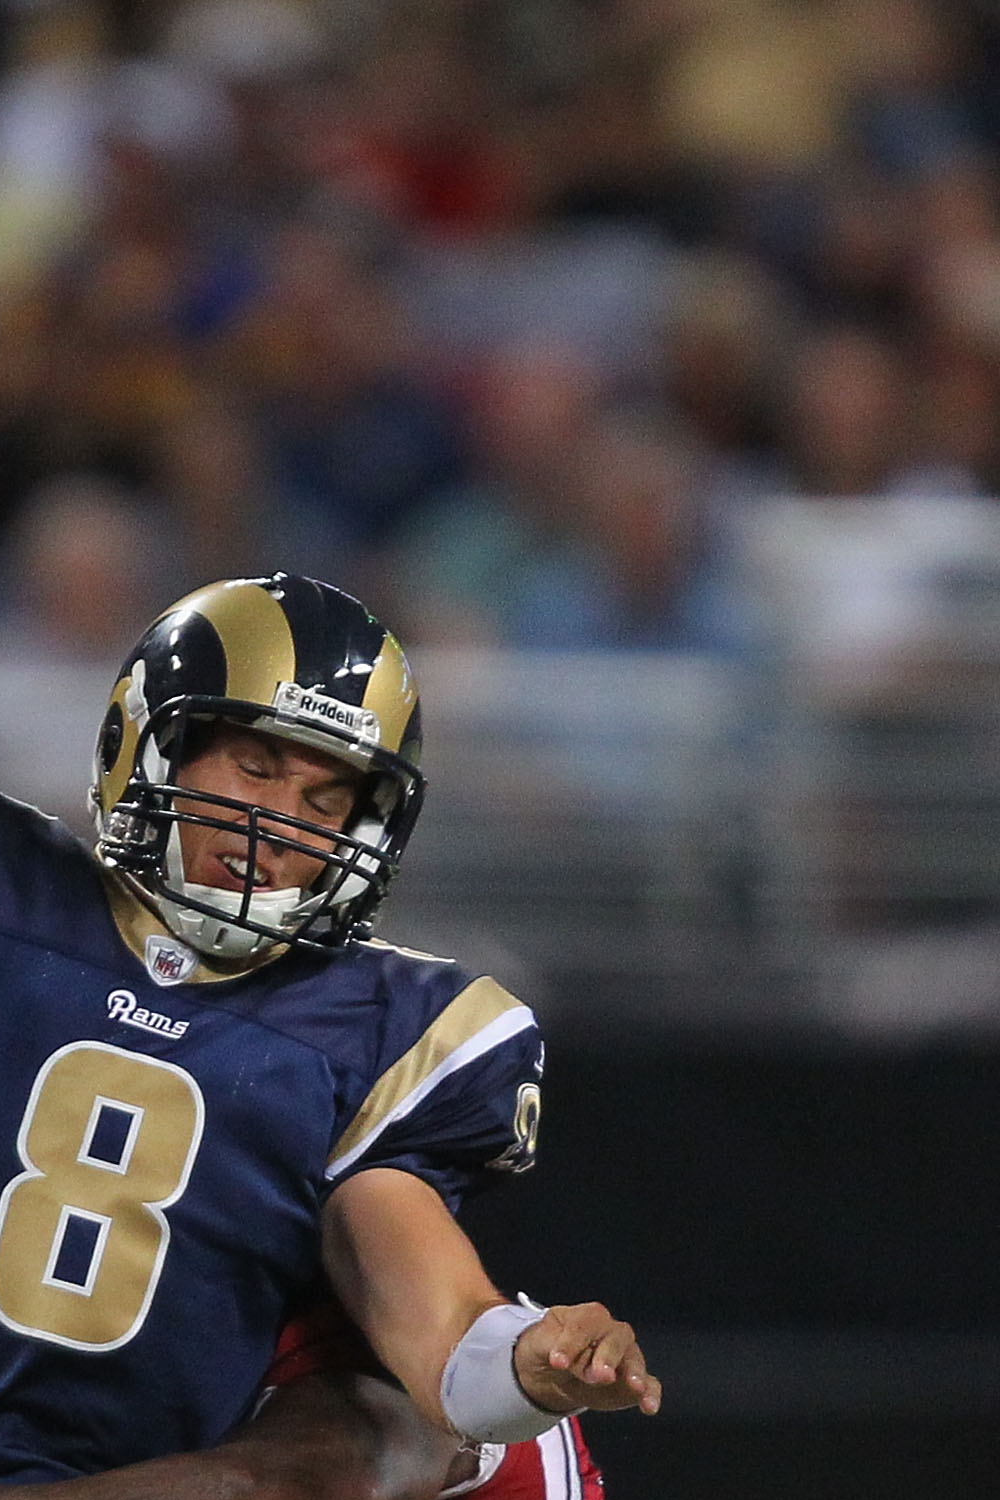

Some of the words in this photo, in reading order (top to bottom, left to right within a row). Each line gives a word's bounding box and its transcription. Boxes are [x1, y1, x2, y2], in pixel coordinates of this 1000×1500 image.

[300, 695, 355, 727] Riddell
[155, 959, 179, 977] NFL
[107, 989, 190, 1039] Rams
